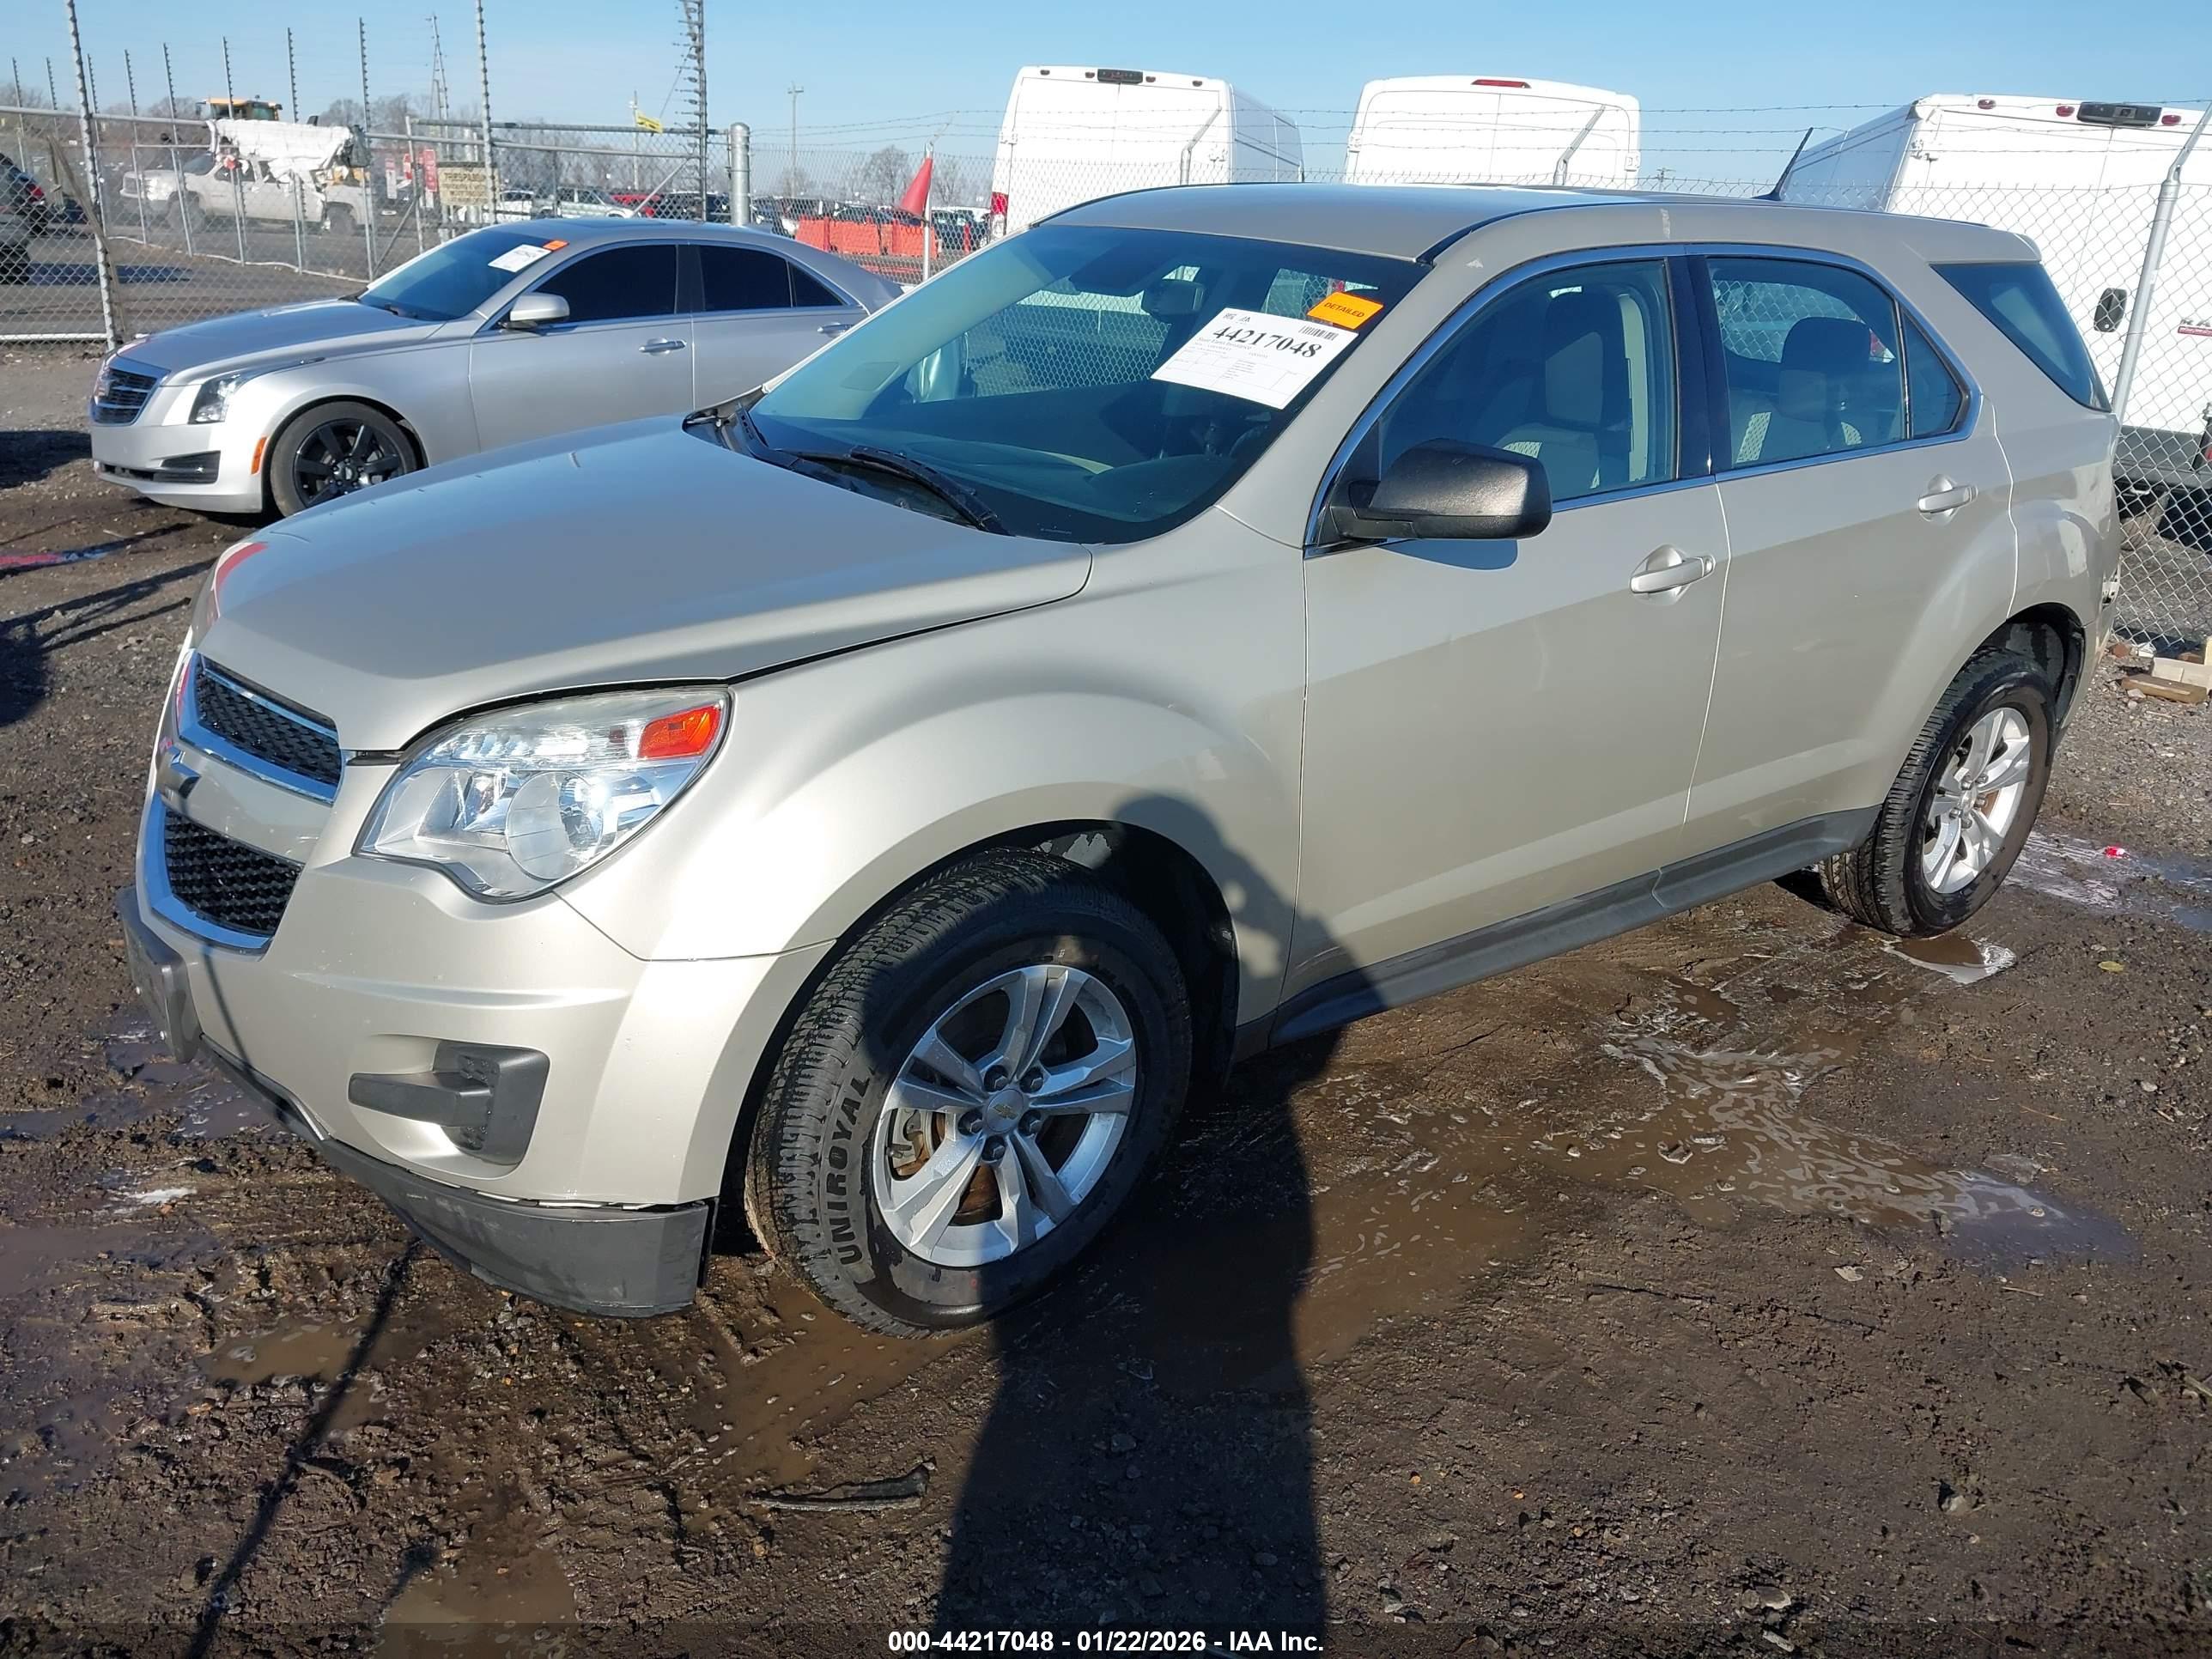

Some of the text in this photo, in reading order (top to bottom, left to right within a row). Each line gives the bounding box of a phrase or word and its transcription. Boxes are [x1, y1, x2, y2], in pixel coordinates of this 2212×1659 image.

[1323, 302, 1365, 318] DETAILED
[1212, 325, 1322, 358] 44217048
[826, 1078, 870, 1265] UNIROYAL
